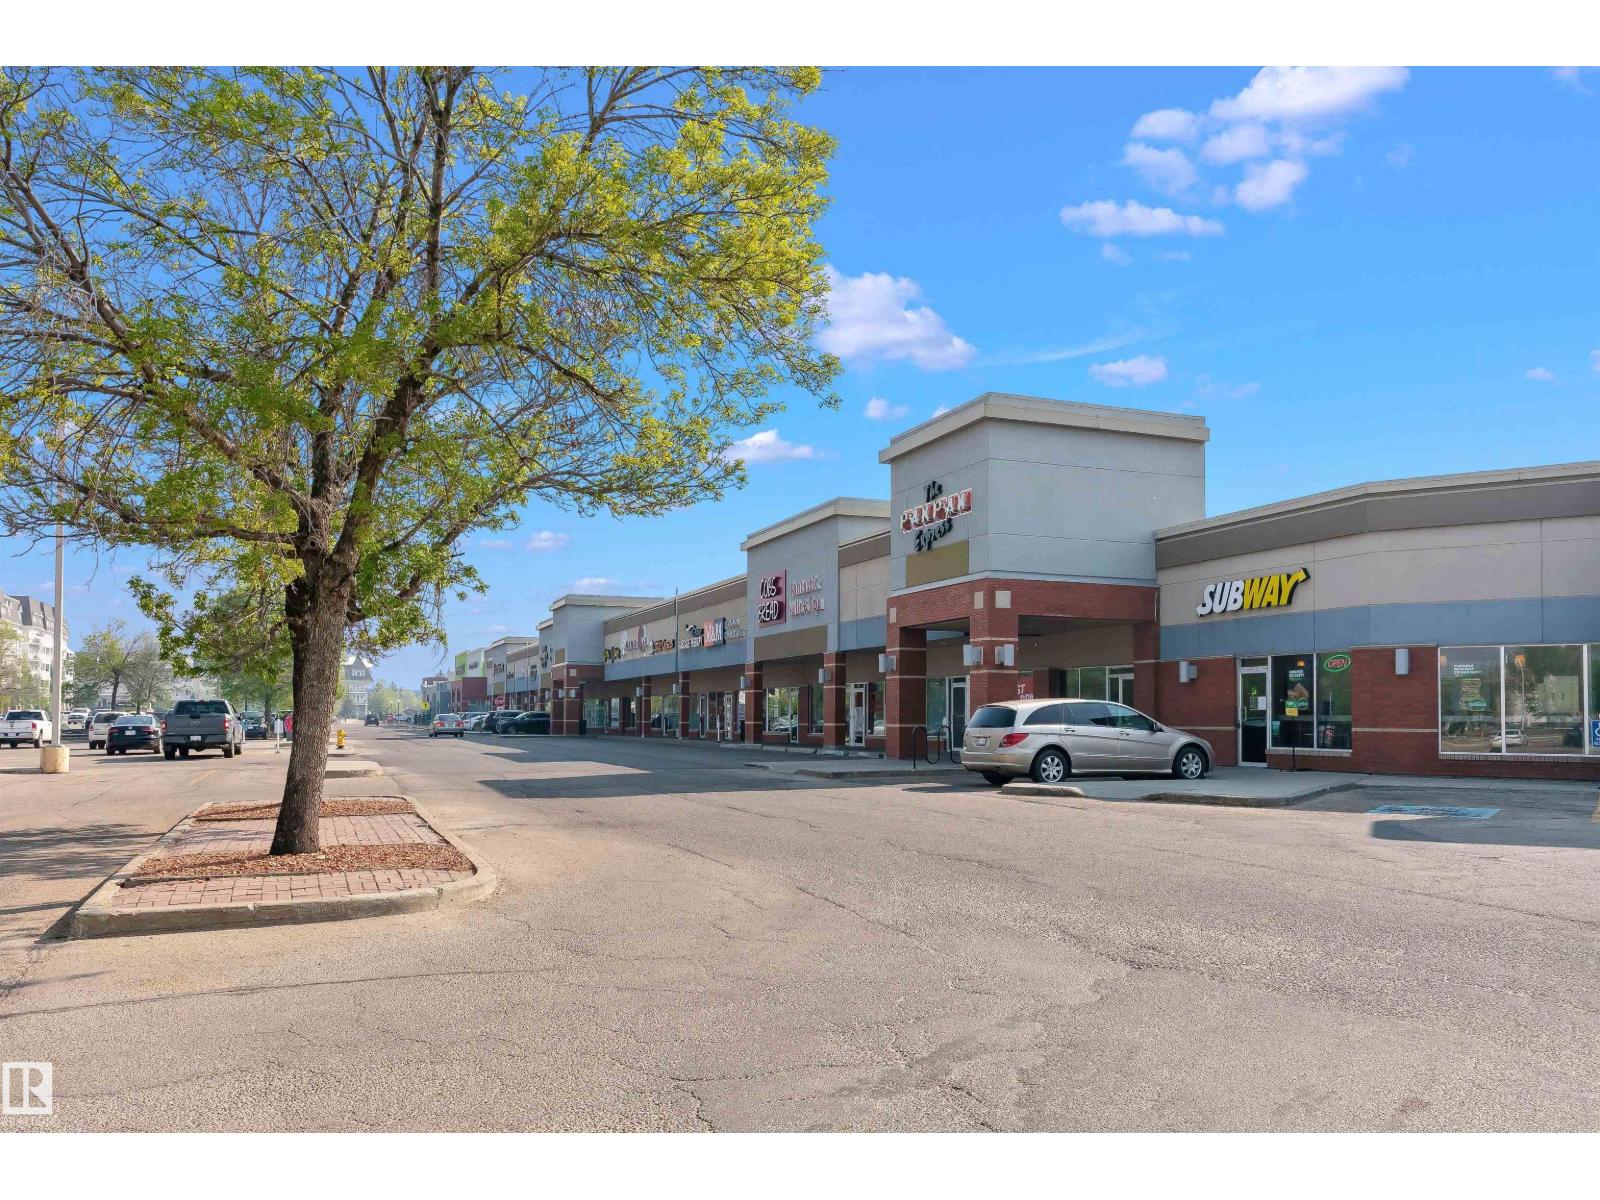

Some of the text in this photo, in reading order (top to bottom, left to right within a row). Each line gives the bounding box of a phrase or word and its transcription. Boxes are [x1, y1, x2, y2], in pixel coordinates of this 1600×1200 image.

[760, 576, 779, 599] COBS
[1195, 567, 1310, 617] SUBWAY
[758, 600, 780, 624] BREAD
[1327, 658, 1347, 668] OPEN
